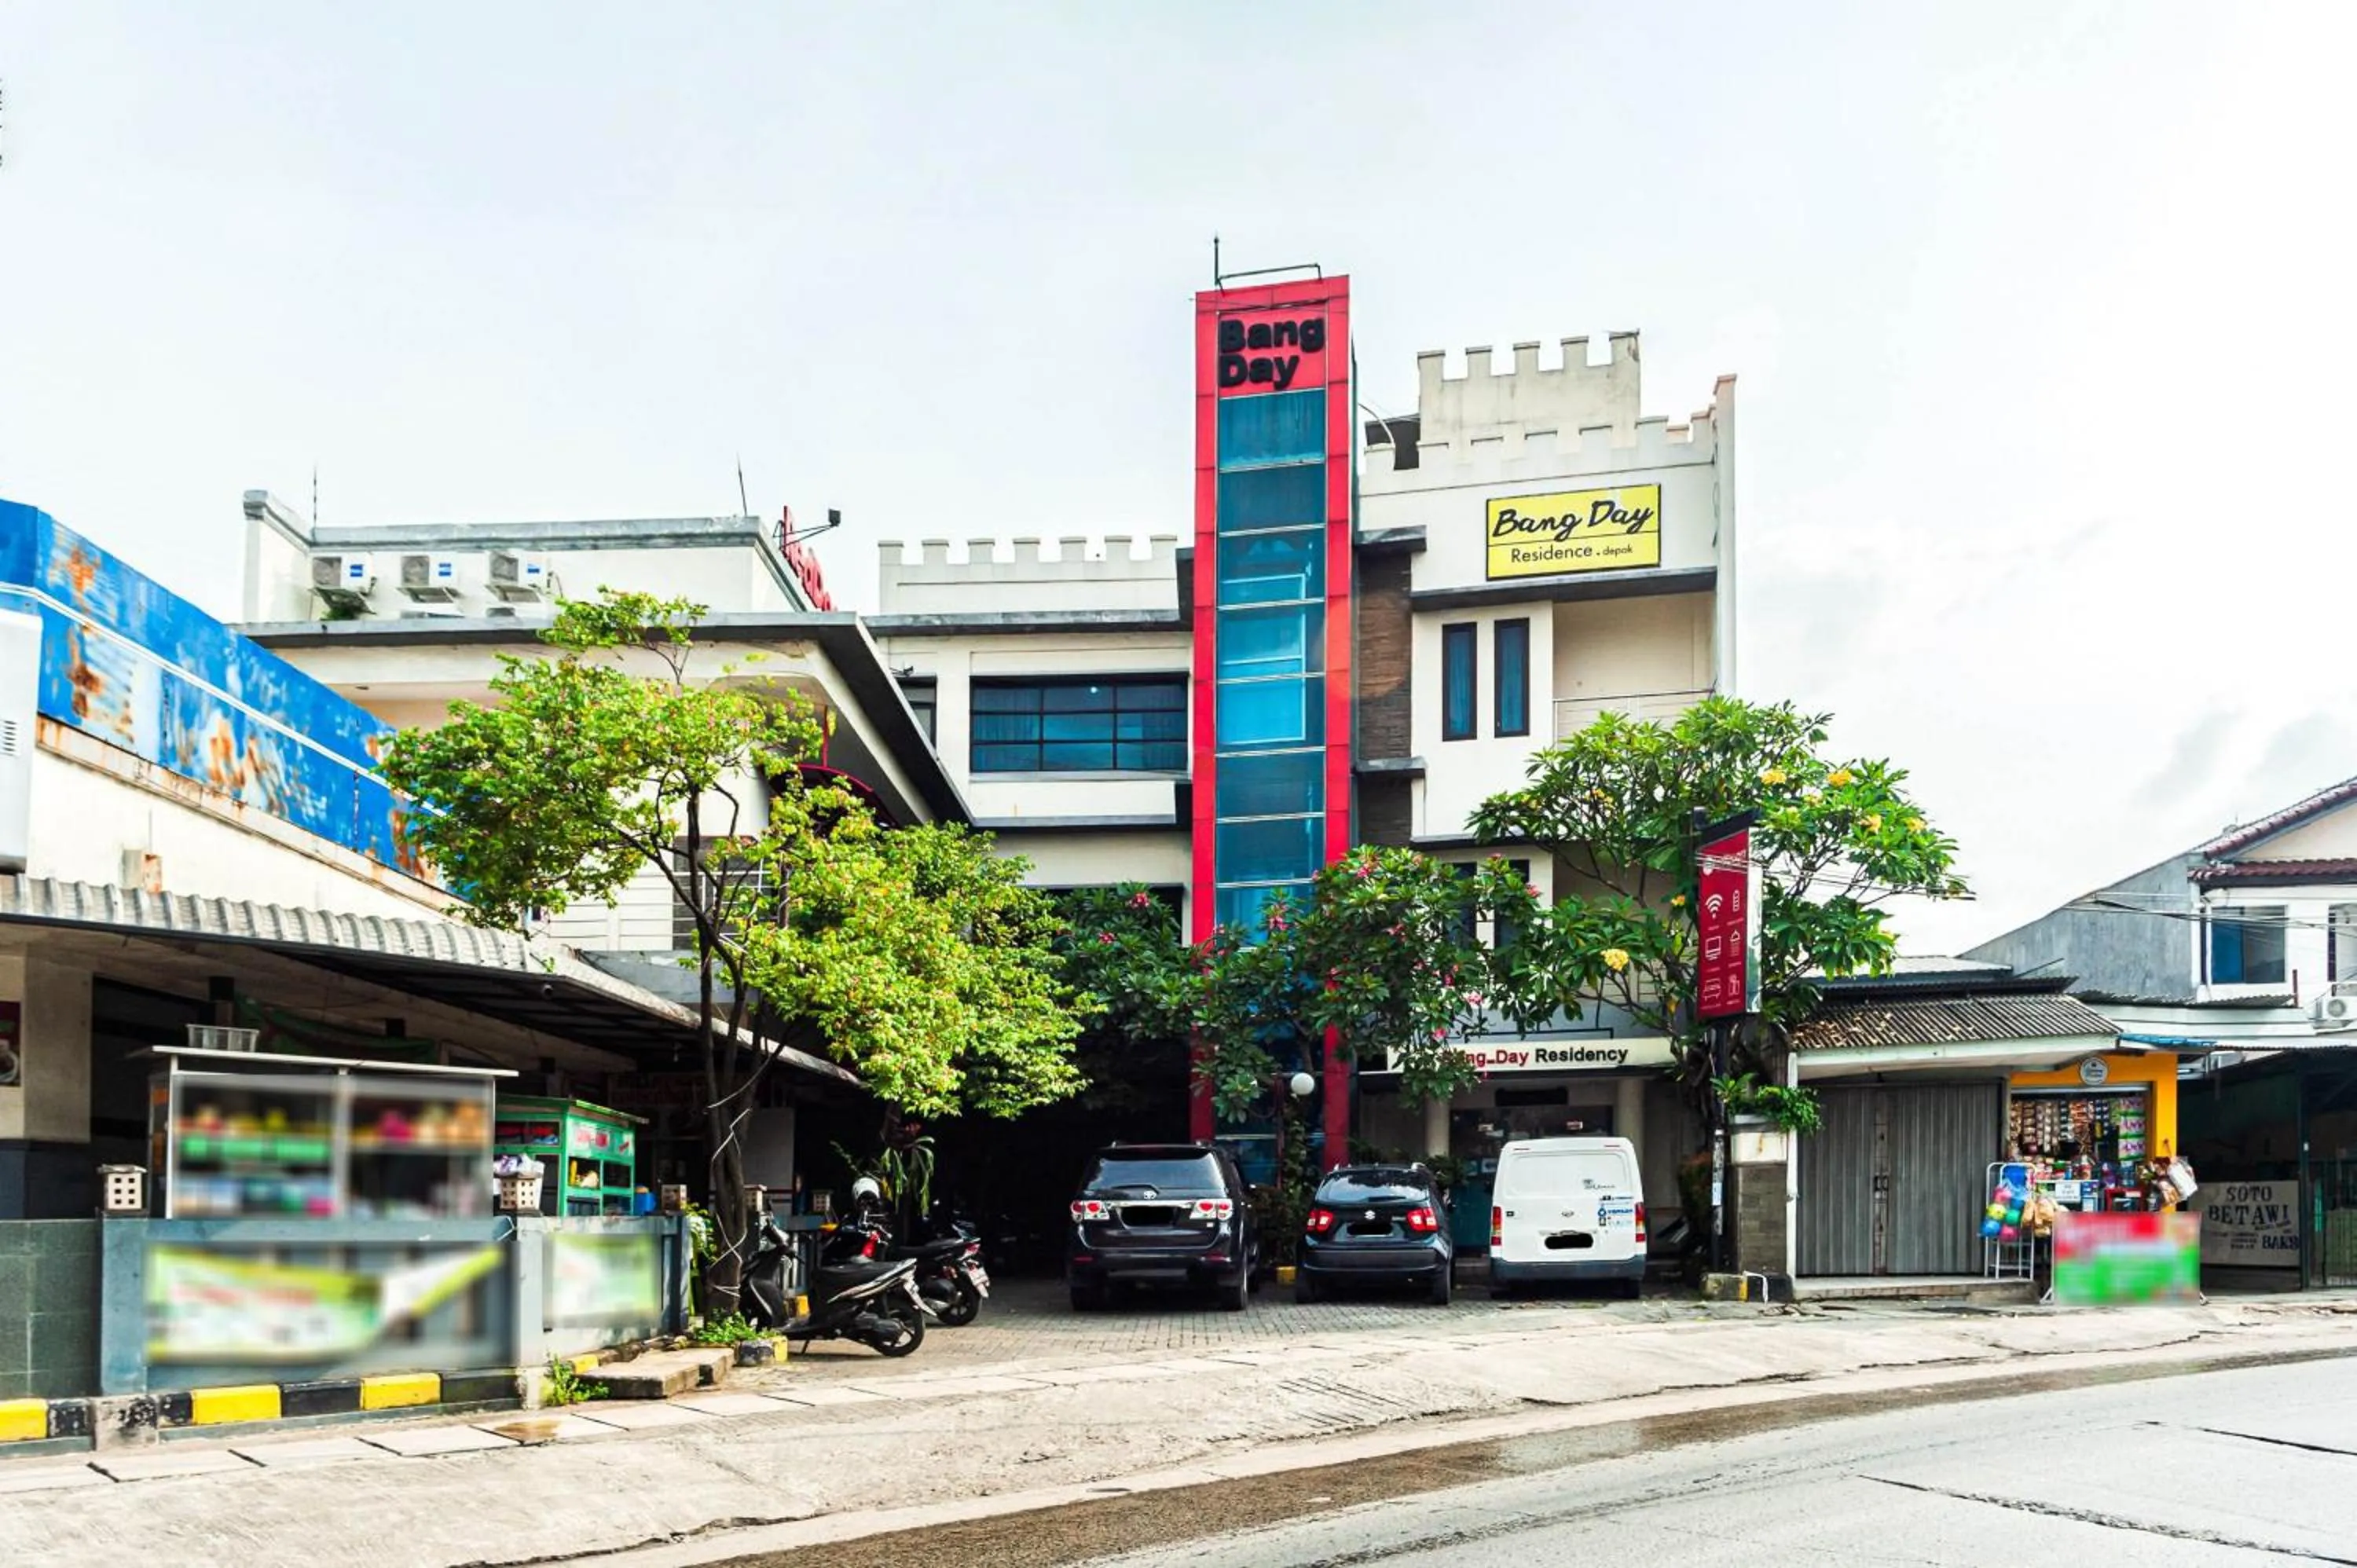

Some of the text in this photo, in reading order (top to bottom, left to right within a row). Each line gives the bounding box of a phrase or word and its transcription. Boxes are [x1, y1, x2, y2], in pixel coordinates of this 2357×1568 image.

[1219, 318, 1325, 354] Bang
[1219, 354, 1300, 390] Day
[1492, 500, 1654, 542] Bang Day
[1534, 1046, 1629, 1064] Residency
[2227, 1185, 2272, 1203] SOTO
[2209, 1204, 2289, 1225] BETAWI
